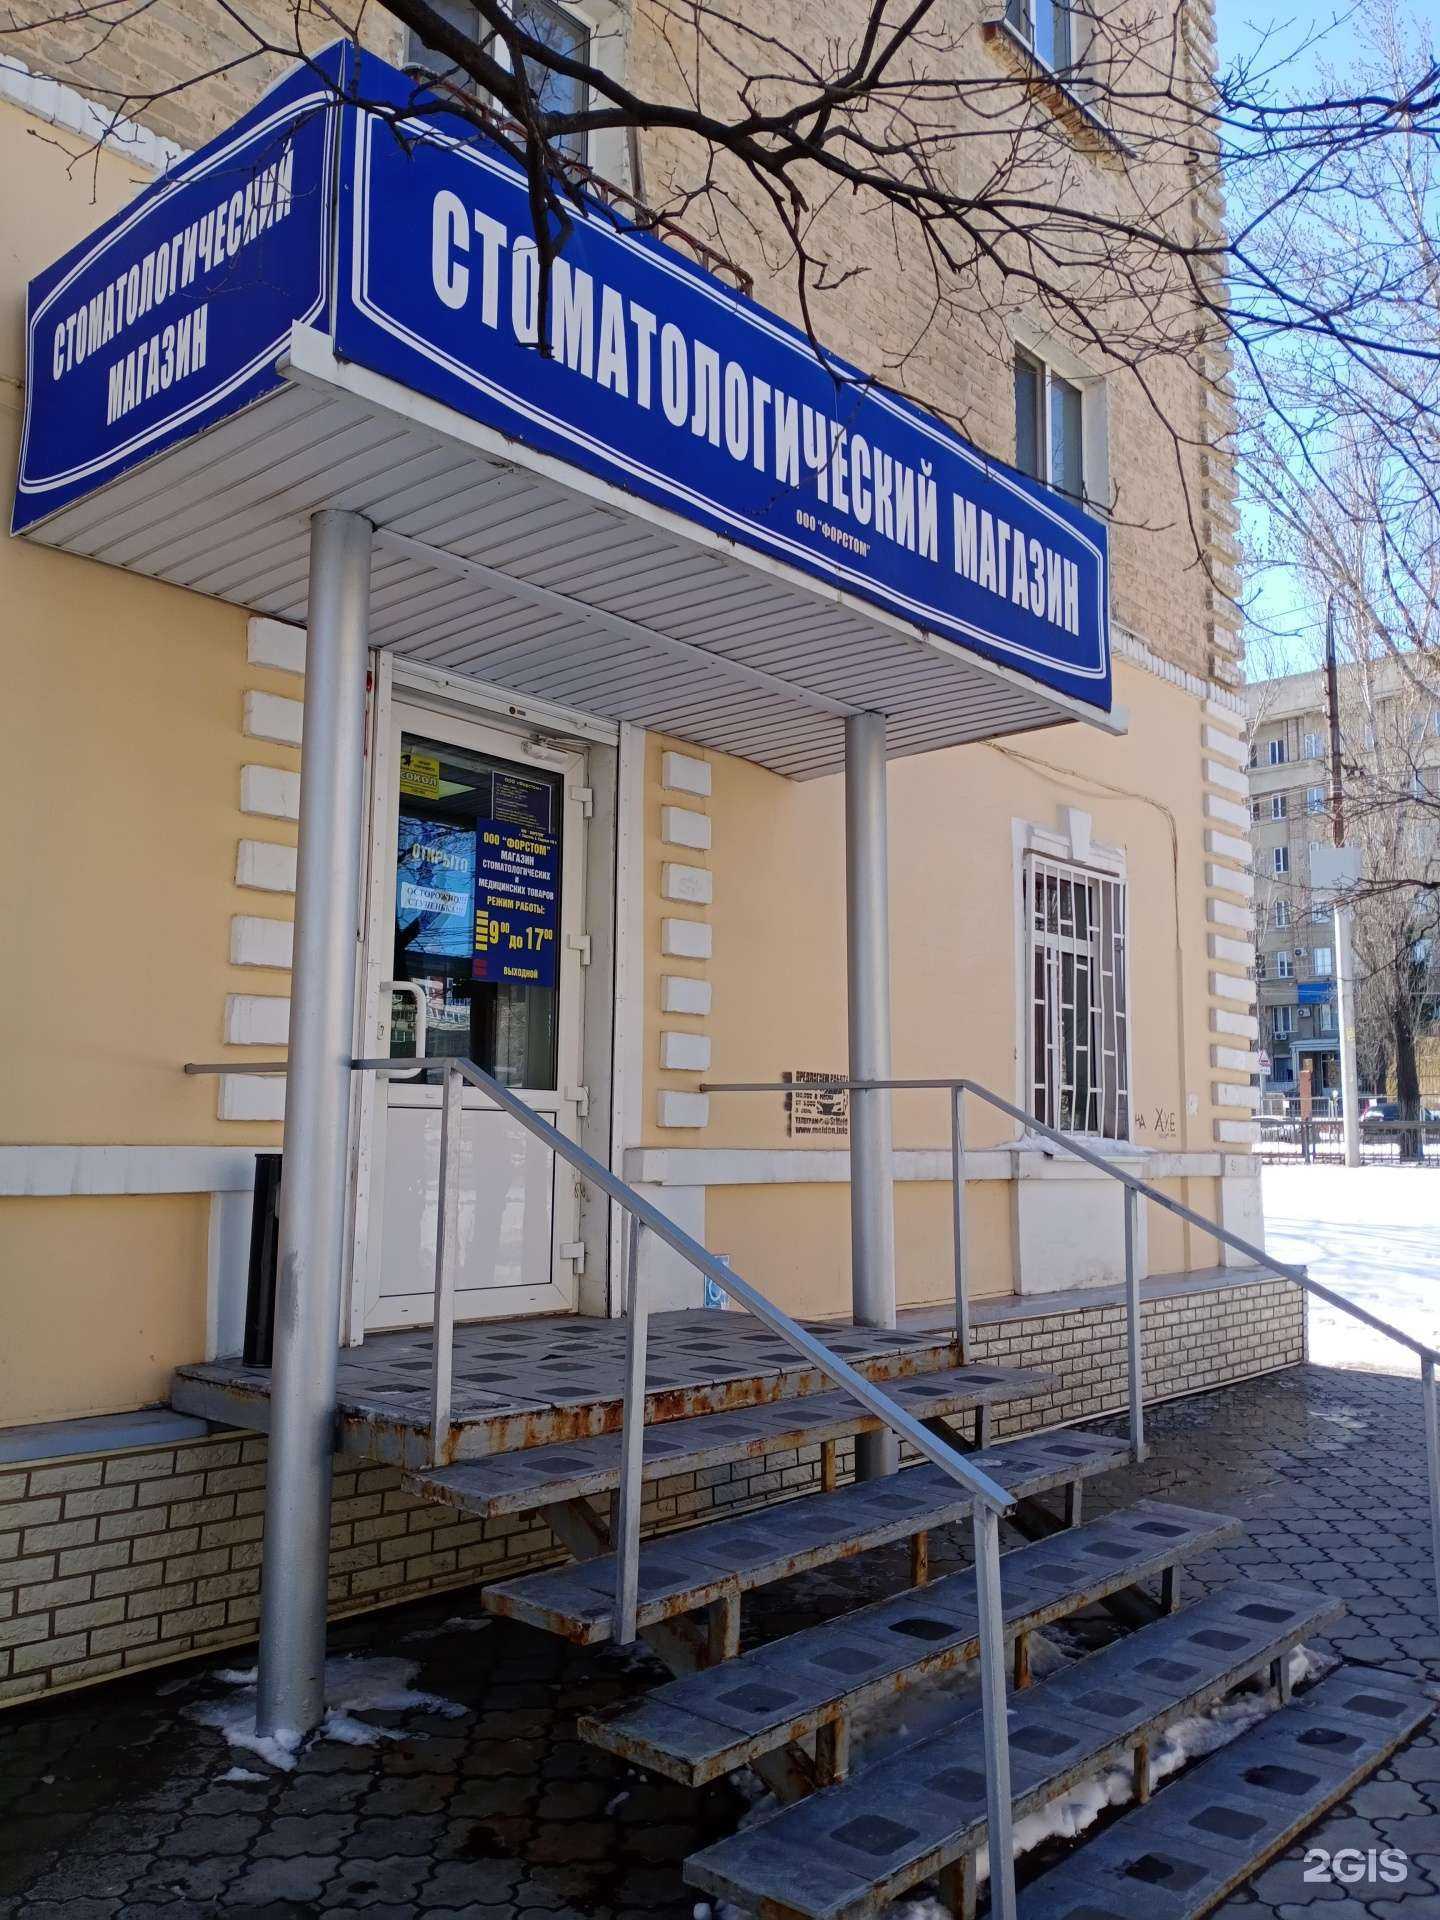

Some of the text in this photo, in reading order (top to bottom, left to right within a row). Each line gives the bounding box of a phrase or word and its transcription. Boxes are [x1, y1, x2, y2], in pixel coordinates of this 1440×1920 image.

[53, 138, 294, 381] СТОМАТОЛОГИЧЕСКИЙ
[106, 303, 208, 426] МАГАЗИН
[432, 190, 1079, 636] СТОМАТОЛОГИЧЕСКИЙ МАГАЗИН
[796, 509, 816, 531] ООО
[483, 832, 500, 845] ООО
[502, 836, 551, 856] "ФОРСТОМ"
[500, 850, 535, 866] МАГАЗИН
[482, 859, 551, 880] СТОМАТОЛОГИЧЕСКИХ
[478, 878, 554, 900] МЕДИЦИНСКИХ ТОВАРОВ
[487, 896, 513, 909] РЕЖИМ
[503, 966, 538, 979] ВЫХОДНОЙ
